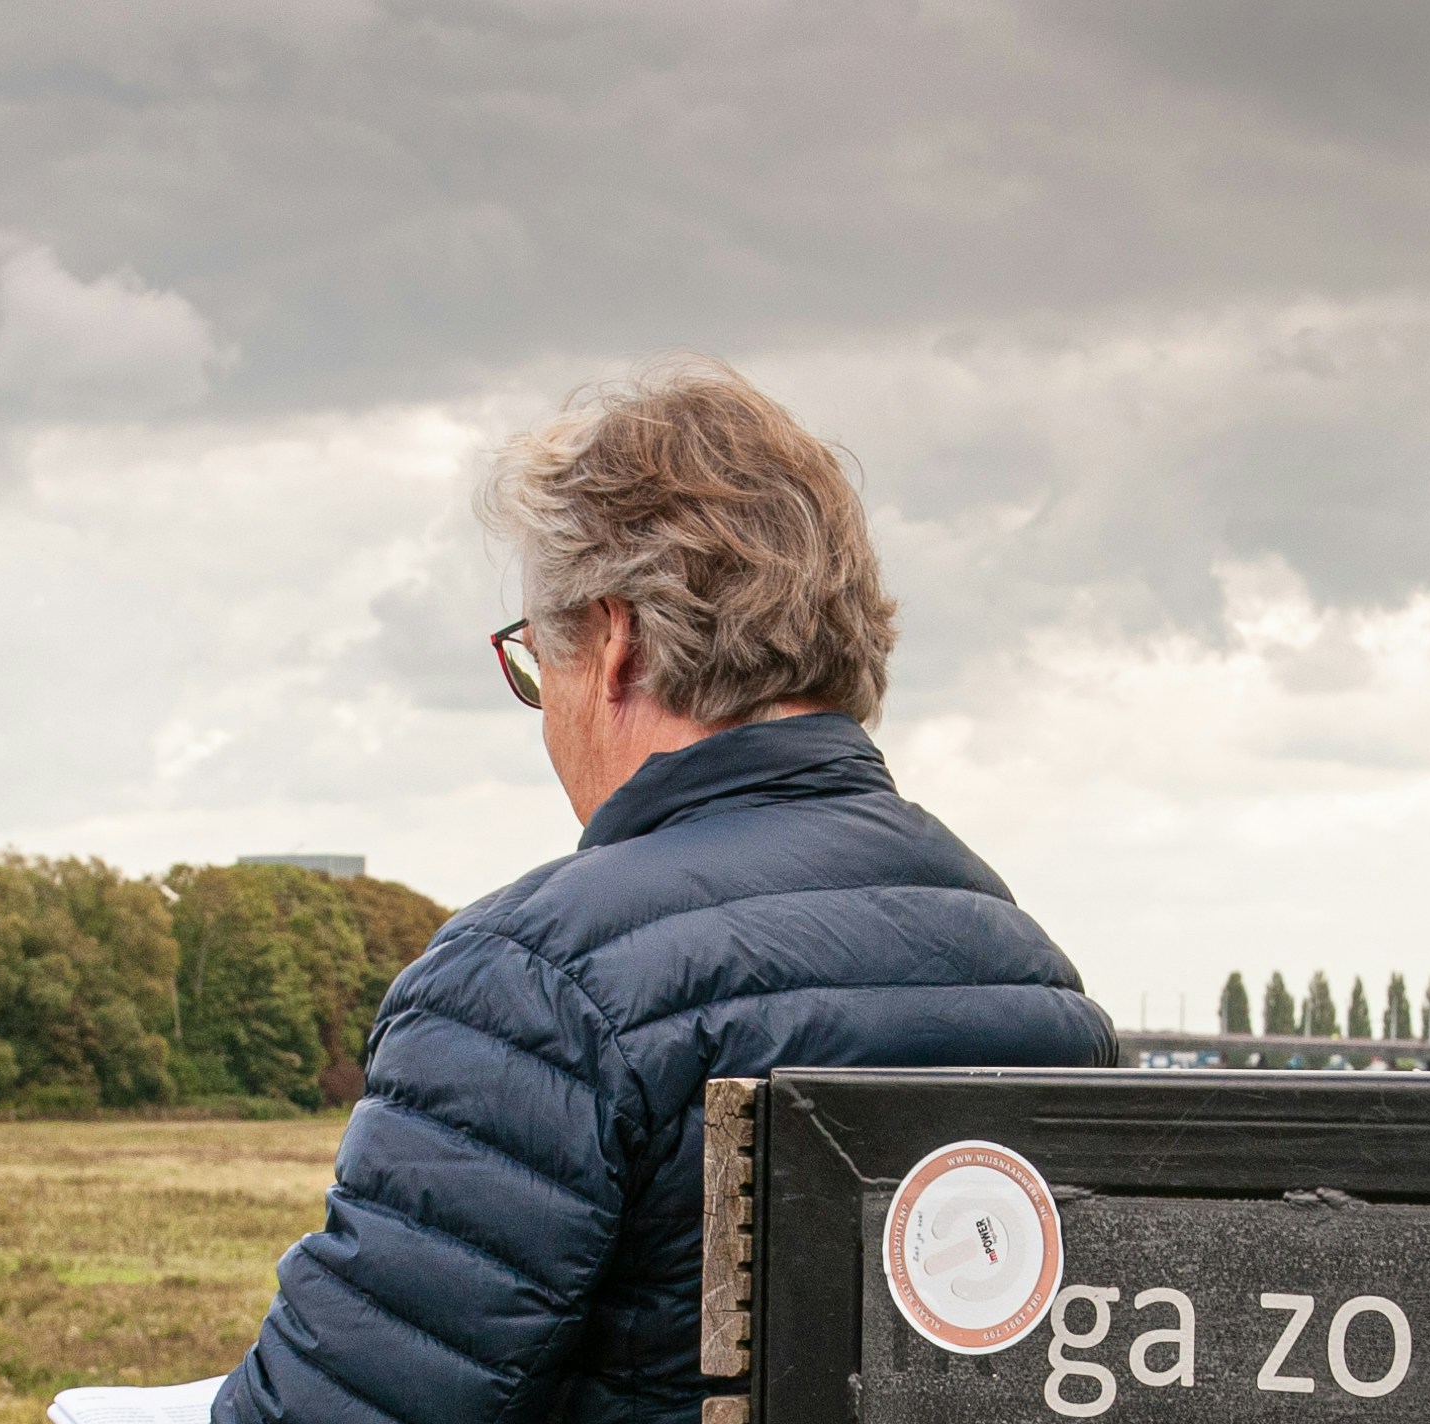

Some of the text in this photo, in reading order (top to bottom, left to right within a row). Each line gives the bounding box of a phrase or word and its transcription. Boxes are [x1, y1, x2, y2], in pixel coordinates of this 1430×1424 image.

[946, 1153, 1049, 1220] WWW.WIJSNAARWERK.NL
[894, 1203, 941, 1331] KLAAR MET THUISZITTEN?
[982, 1330, 1003, 1342] 799
[1005, 1313, 1027, 1333] 1991
[1043, 1284, 1195, 1417] ga
[1257, 1293, 1412, 1397] zo
